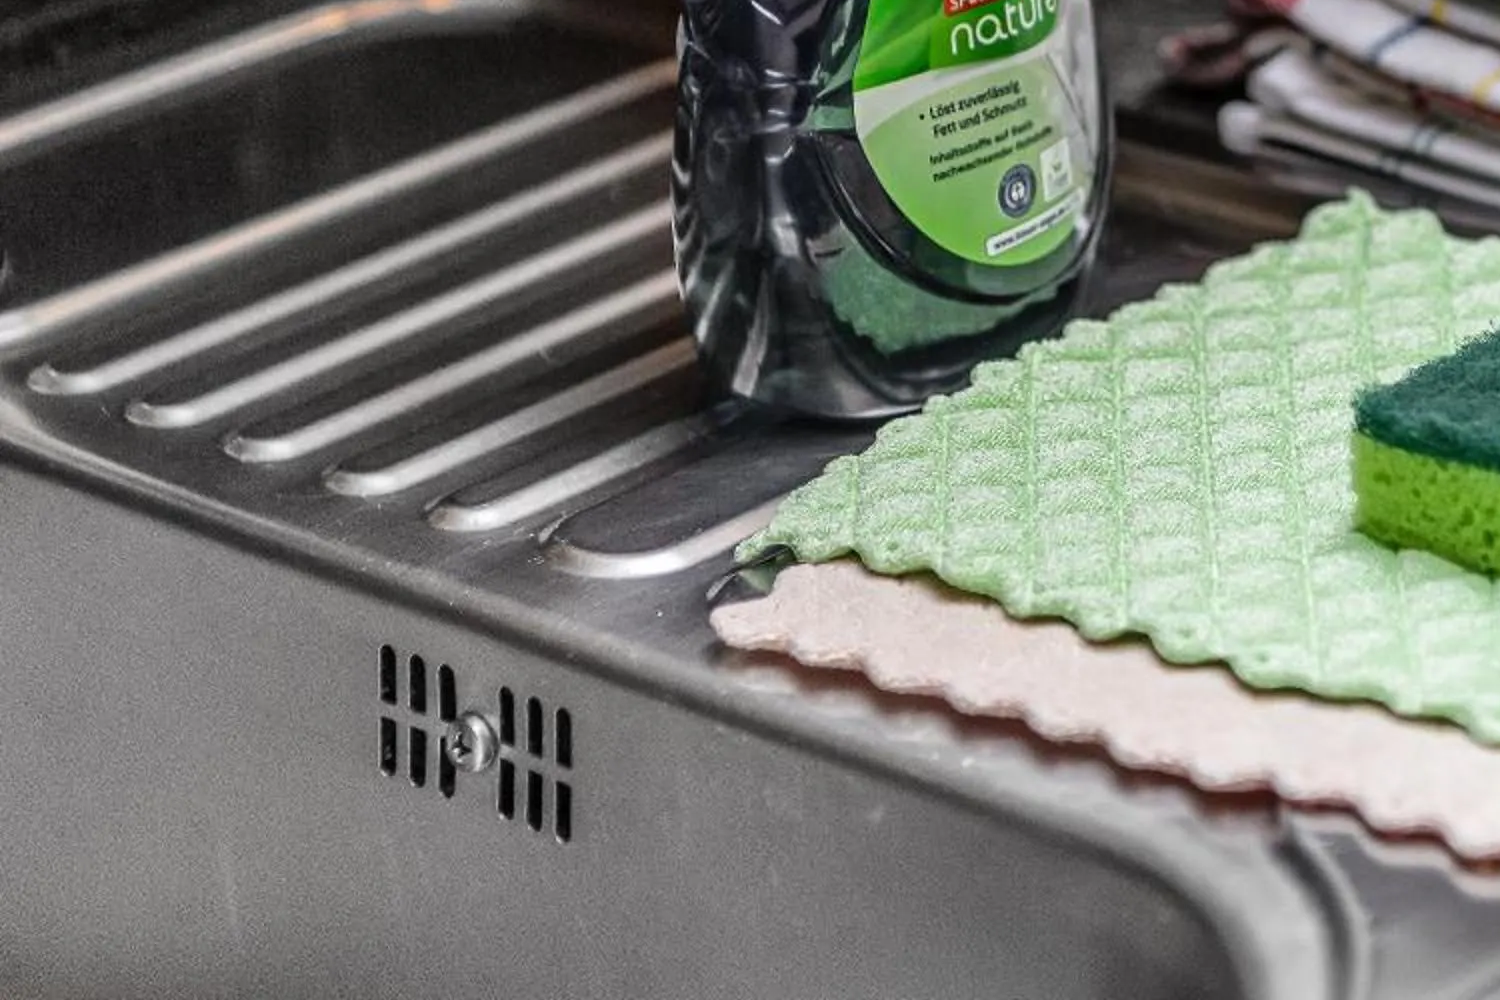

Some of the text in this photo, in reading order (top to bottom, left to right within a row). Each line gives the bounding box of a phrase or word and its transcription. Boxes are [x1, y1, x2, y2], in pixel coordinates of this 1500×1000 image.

[929, 79, 1020, 119] Löst zuverlässig
[933, 96, 1027, 138] Fett und Schmutz
